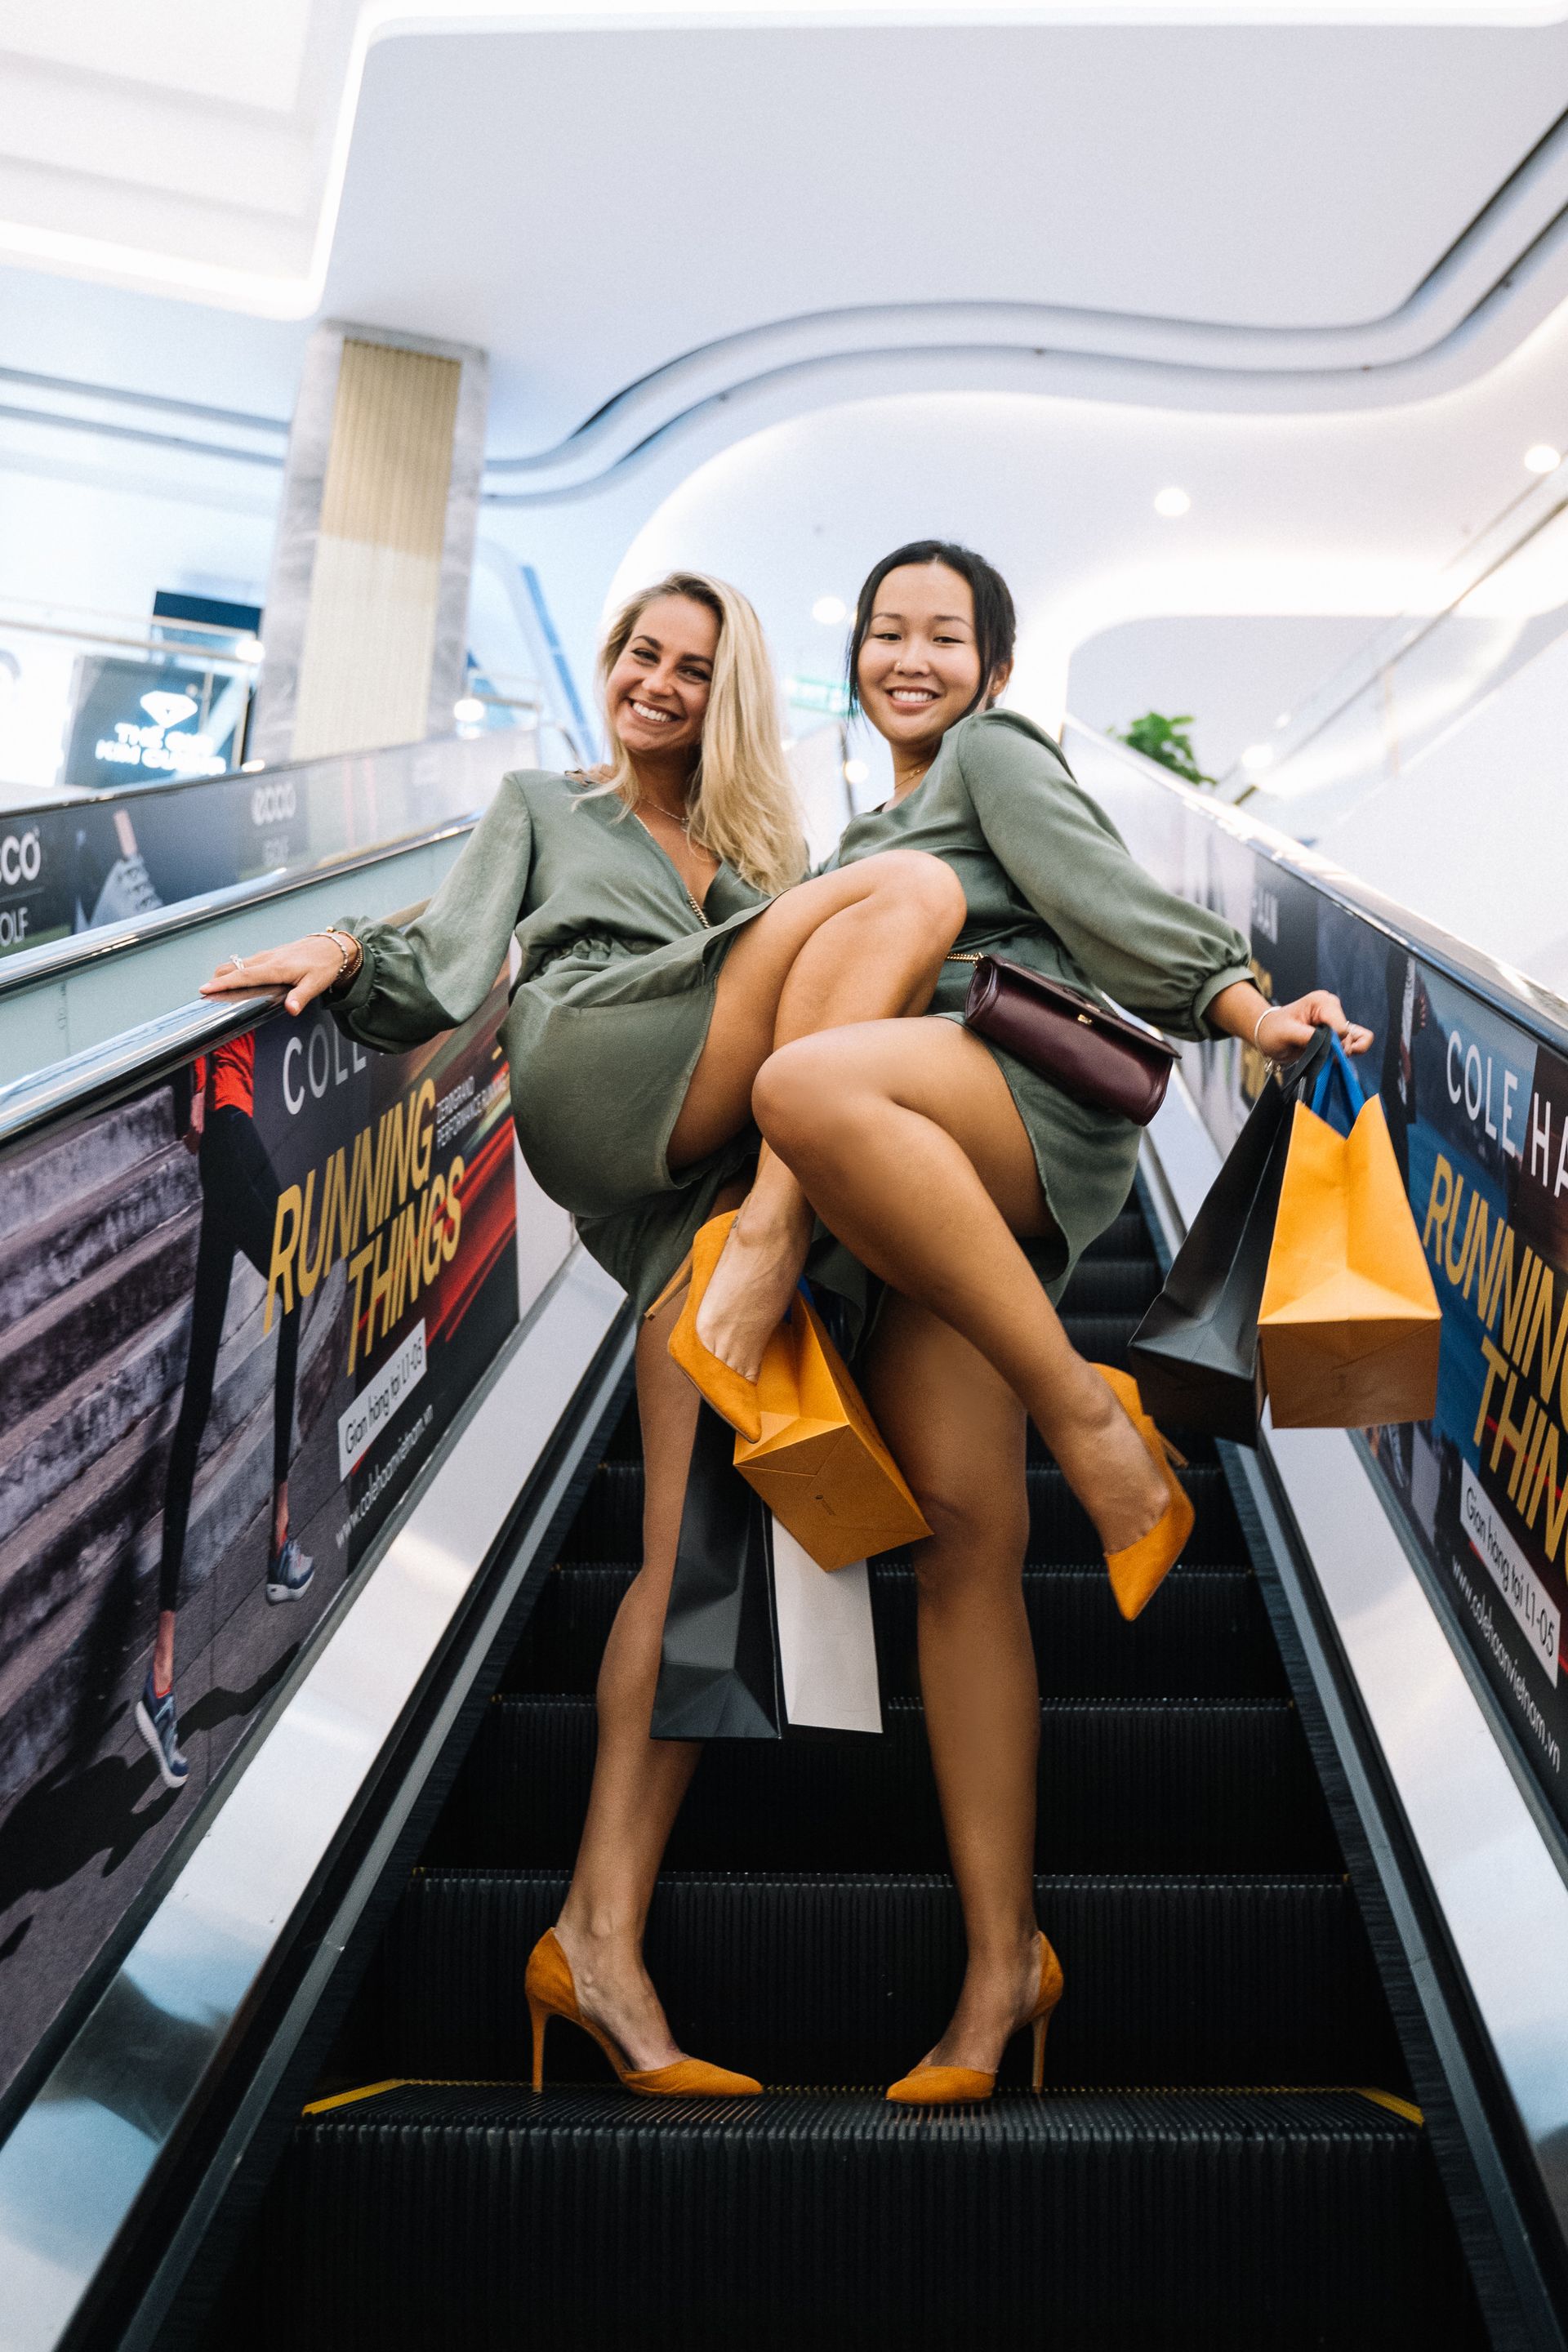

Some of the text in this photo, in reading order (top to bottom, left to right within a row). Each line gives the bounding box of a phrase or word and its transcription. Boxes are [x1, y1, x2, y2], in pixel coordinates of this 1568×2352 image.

[1447, 1031, 1517, 1158] COLE
[264, 1079, 435, 1338] RUNNING
[347, 1156, 465, 1378] THINGS
[1423, 1153, 1568, 1437] RUNNIN
[345, 1416, 367, 1454] Gian
[1473, 1334, 1568, 1584] THIN
[1466, 1486, 1486, 1544] Gian
[1525, 1583, 1555, 1657] L1-05
